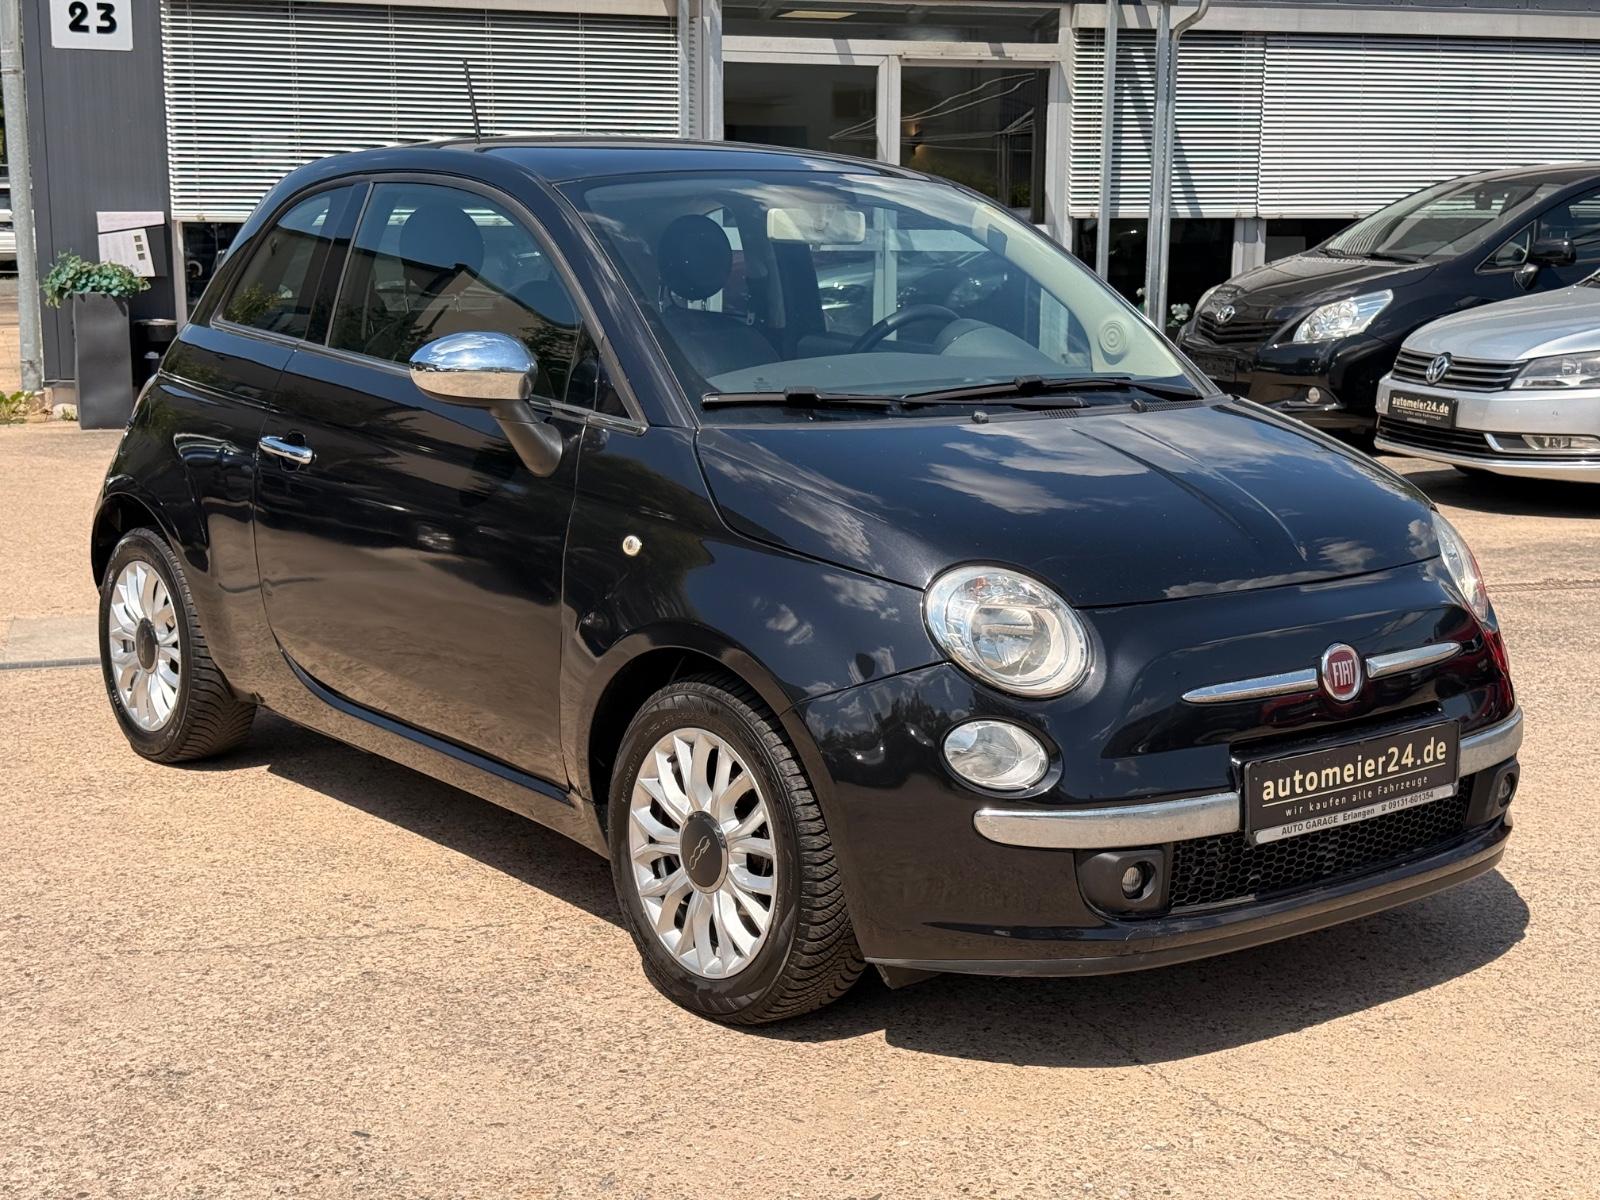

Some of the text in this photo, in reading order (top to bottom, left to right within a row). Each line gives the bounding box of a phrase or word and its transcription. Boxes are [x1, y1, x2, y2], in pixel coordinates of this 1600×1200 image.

[68, 1, 118, 35] 23
[1392, 396, 1450, 414] automeier24.de
[1331, 659, 1354, 687] FIAT
[1262, 737, 1447, 801] automeier24.de
[1285, 776, 1428, 817] wir kaufen alle Fahrzeuge
[1281, 823, 1304, 836] AUTO
[1305, 814, 1339, 831] GARAGE
[1342, 808, 1375, 822] Erlangen
